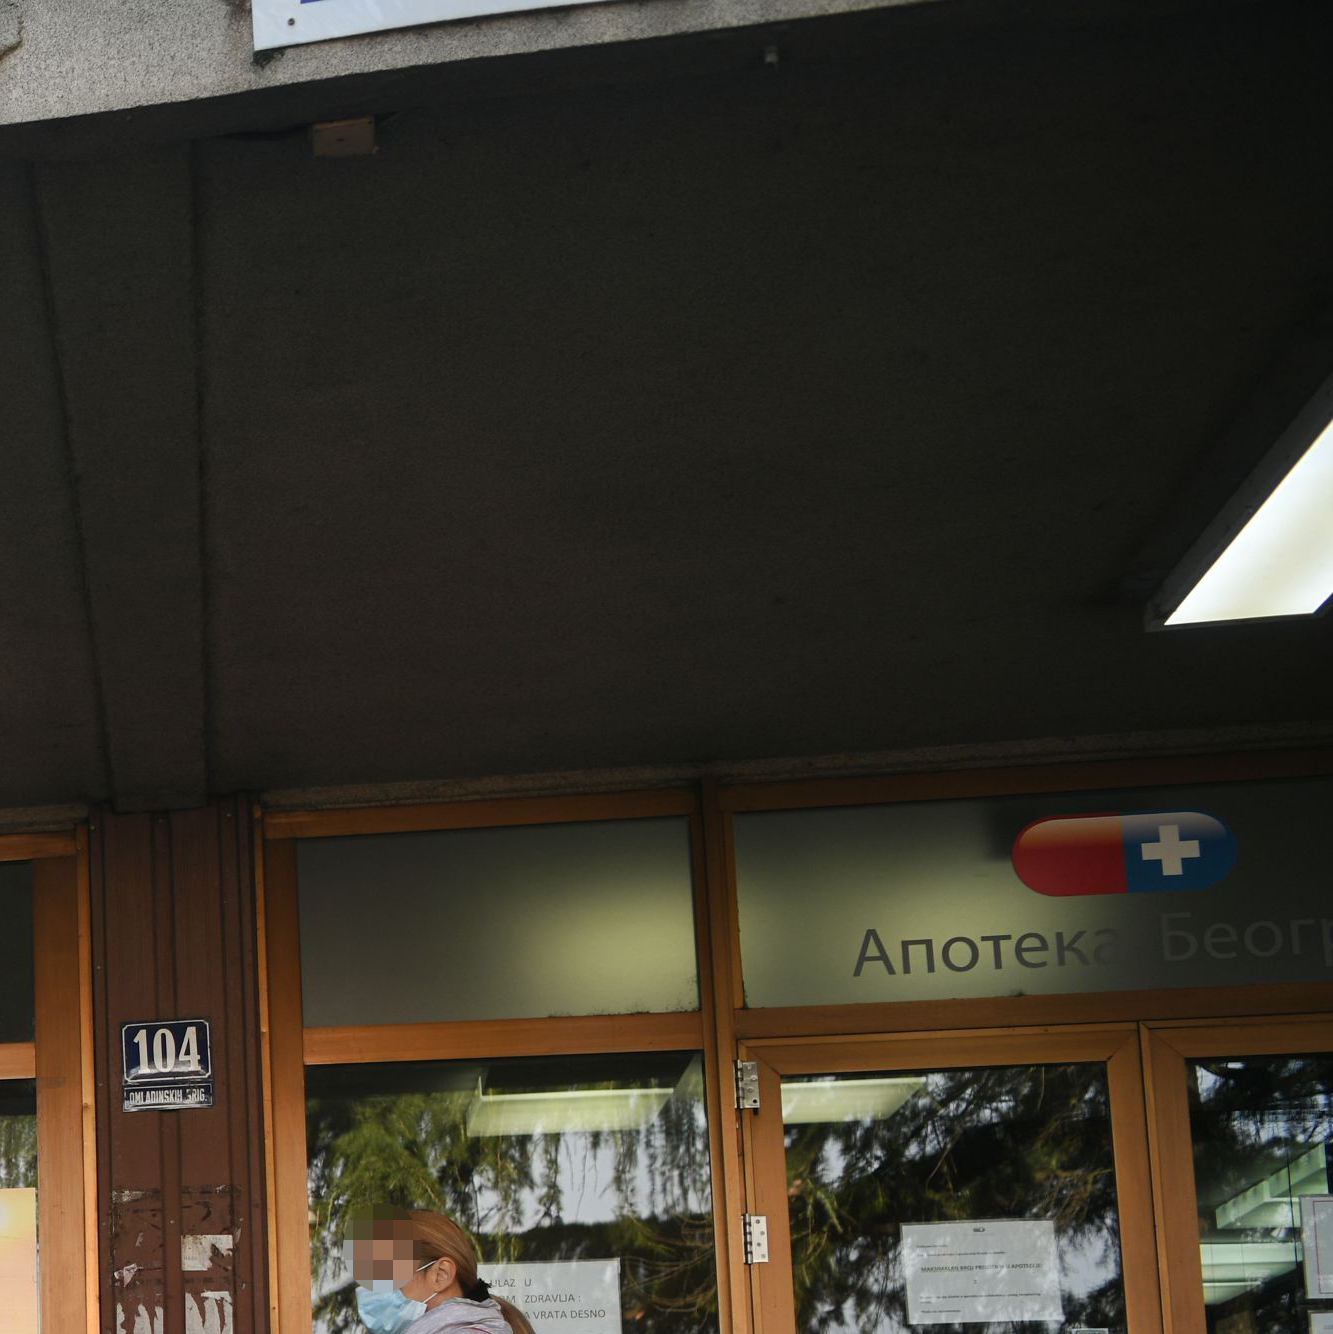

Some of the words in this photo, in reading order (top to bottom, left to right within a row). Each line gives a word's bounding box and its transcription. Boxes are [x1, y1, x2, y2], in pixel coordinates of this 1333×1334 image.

[852, 928, 1120, 977] Апотека
[133, 1026, 201, 1074] 104
[129, 1089, 182, 1104] OMLADINSKIH
[490, 1279, 516, 1288] ULAZ
[524, 1279, 532, 1287] U
[533, 1311, 567, 1320] VRATA
[570, 1309, 606, 1318] DESNO
